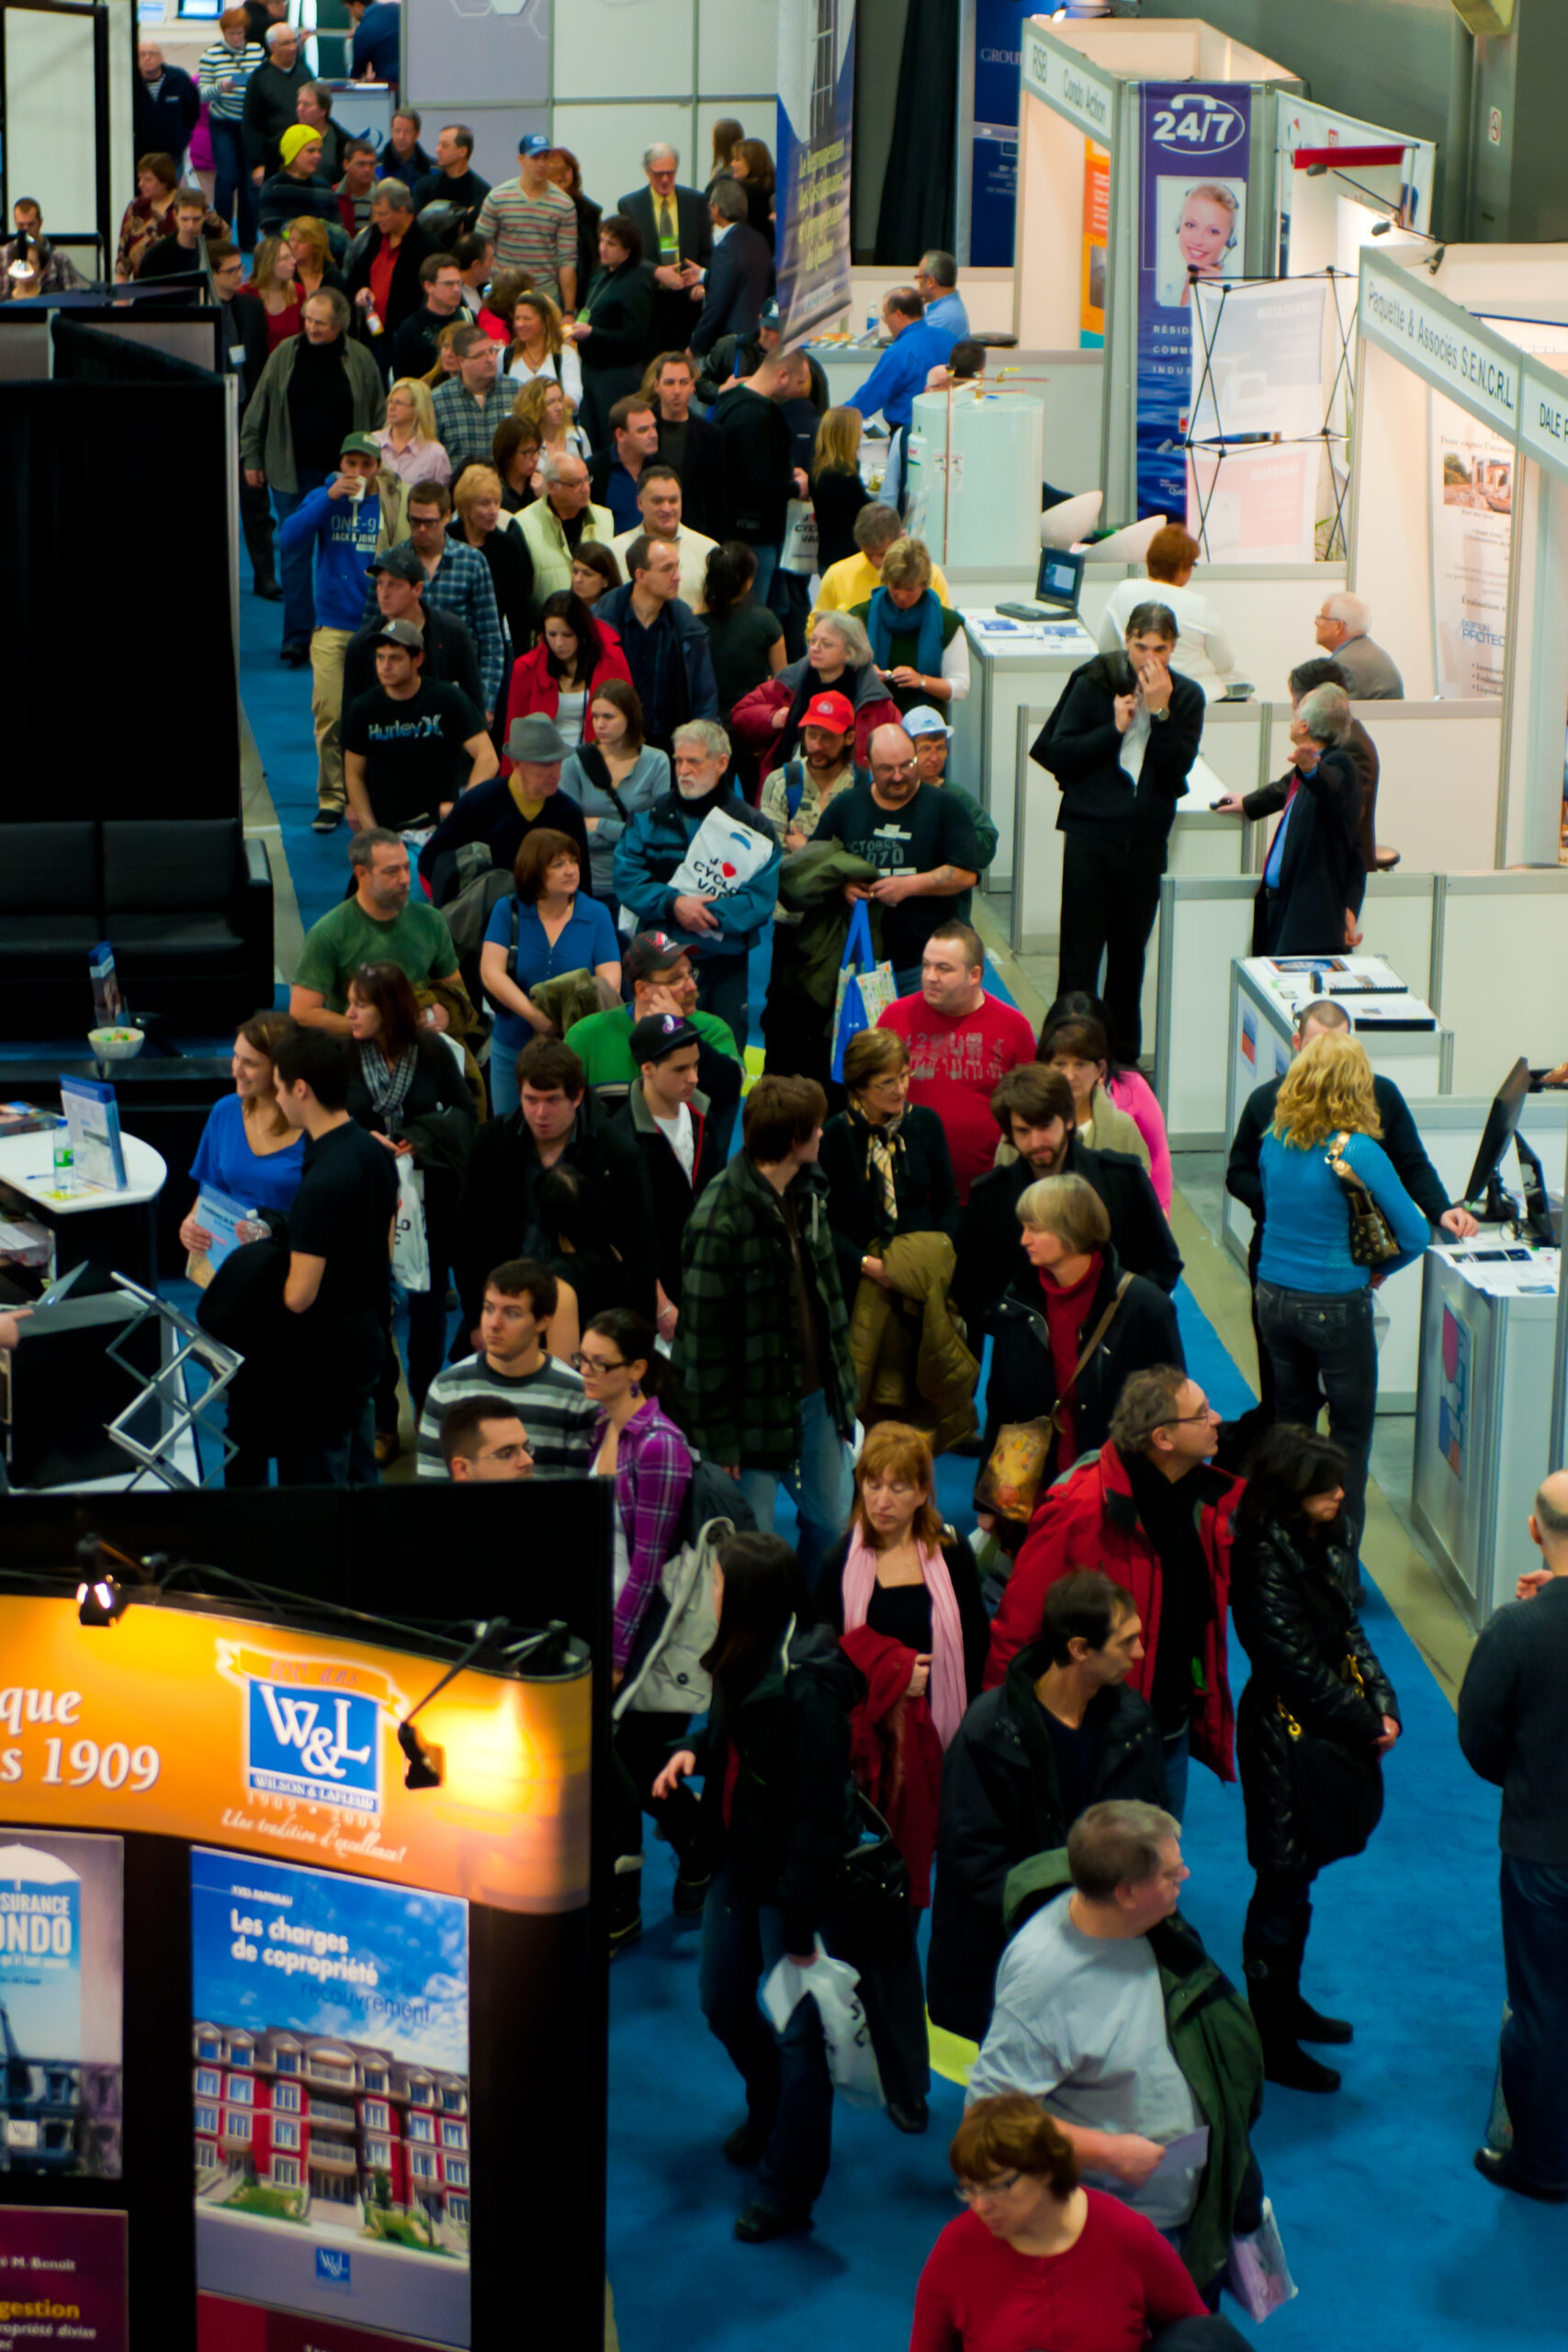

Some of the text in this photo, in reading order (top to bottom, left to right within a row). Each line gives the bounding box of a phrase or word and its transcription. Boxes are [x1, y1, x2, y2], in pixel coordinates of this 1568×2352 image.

[1033, 43, 1106, 125] RSB Condo Action
[1153, 111, 1235, 143] 24/7
[1153, 323, 1192, 335] RÉSID
[1369, 280, 1405, 332] Paquette
[1407, 308, 1415, 339] &
[1417, 315, 1458, 370] Associés
[1539, 401, 1562, 439] DALE
[367, 719, 423, 741] Hurley
[269, 1660, 309, 1682] 100
[258, 1683, 371, 1780] W&L
[41, 1737, 161, 1793] 1909
[246, 1791, 297, 1812] 1909
[253, 1775, 306, 1796] WILSON
[308, 1785, 318, 1798] &
[221, 1807, 253, 1830] Une
[258, 1814, 317, 1844] tradition
[0, 1892, 70, 1916] SURANCE
[231, 1908, 350, 1956] Les charges
[231, 1934, 378, 1987] de copropriété
[300, 1982, 431, 2023] recouvrement
[0, 2298, 81, 2322] gestion
[57, 2324, 97, 2341] divise
